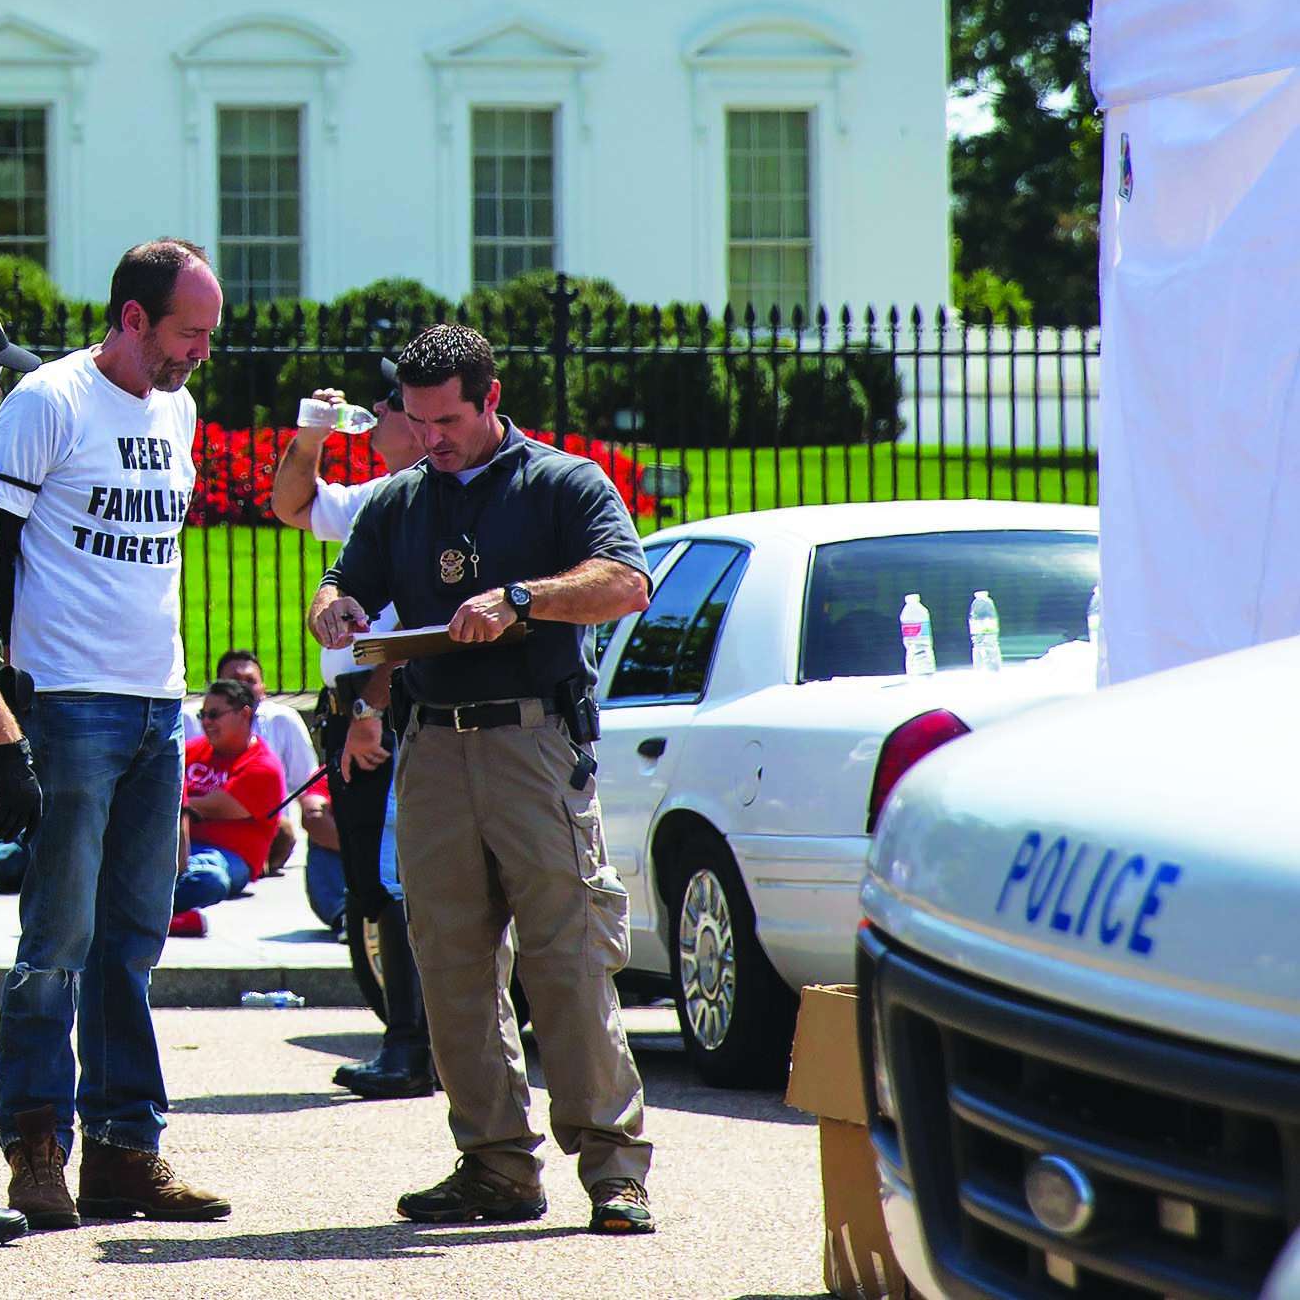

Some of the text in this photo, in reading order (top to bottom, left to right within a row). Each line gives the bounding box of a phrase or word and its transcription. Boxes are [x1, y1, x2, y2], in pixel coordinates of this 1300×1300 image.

[117, 437, 172, 470] KEEP
[87, 486, 191, 523] FAMILIE
[995, 830, 1181, 955] POLICE
